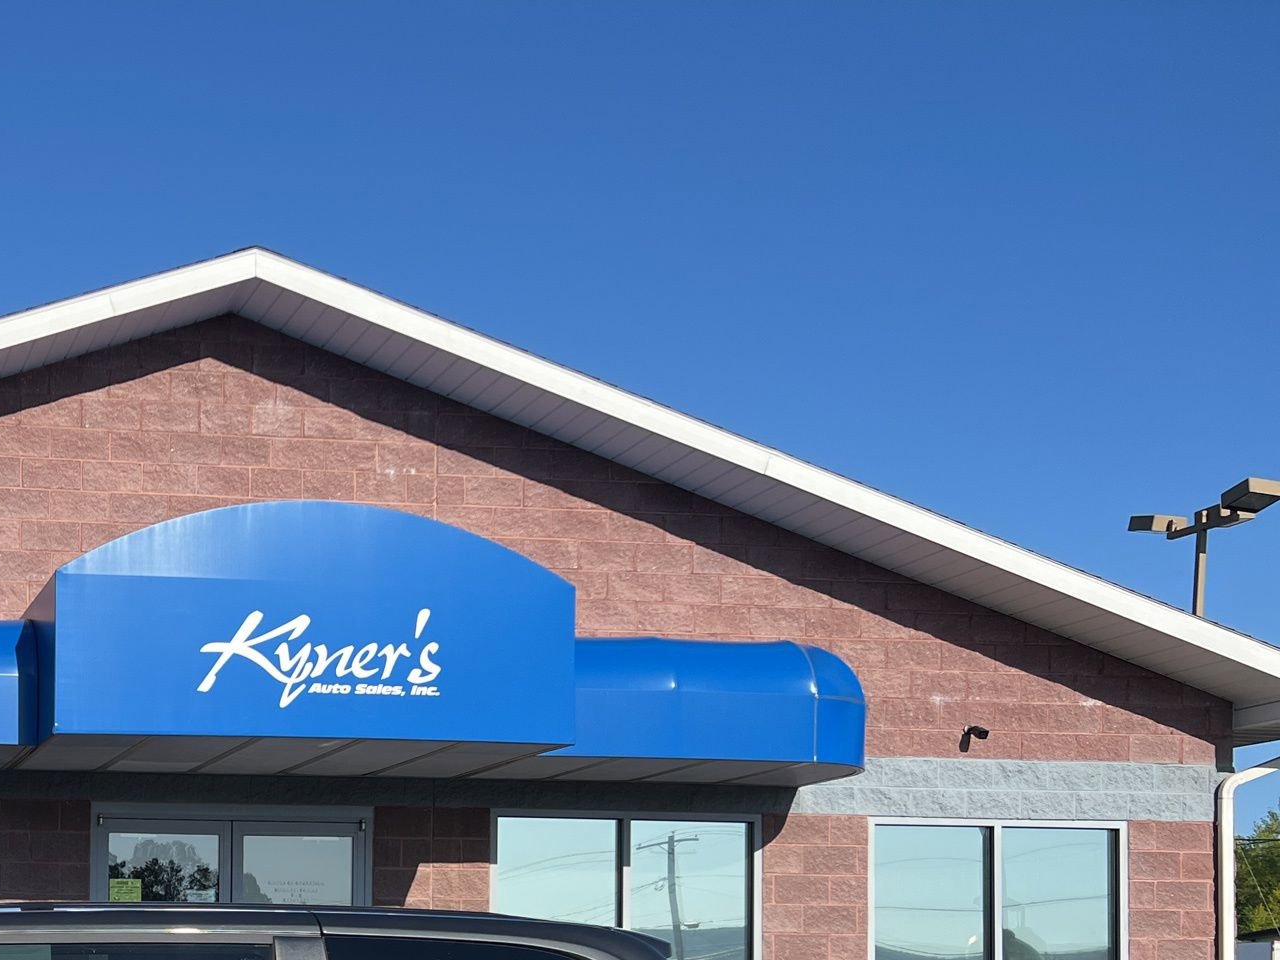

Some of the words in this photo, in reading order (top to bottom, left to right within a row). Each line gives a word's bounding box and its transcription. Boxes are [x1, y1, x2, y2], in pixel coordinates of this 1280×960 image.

[196, 608, 442, 708] Kyner's
[308, 683, 352, 695] Auto
[354, 683, 406, 697] Sales,
